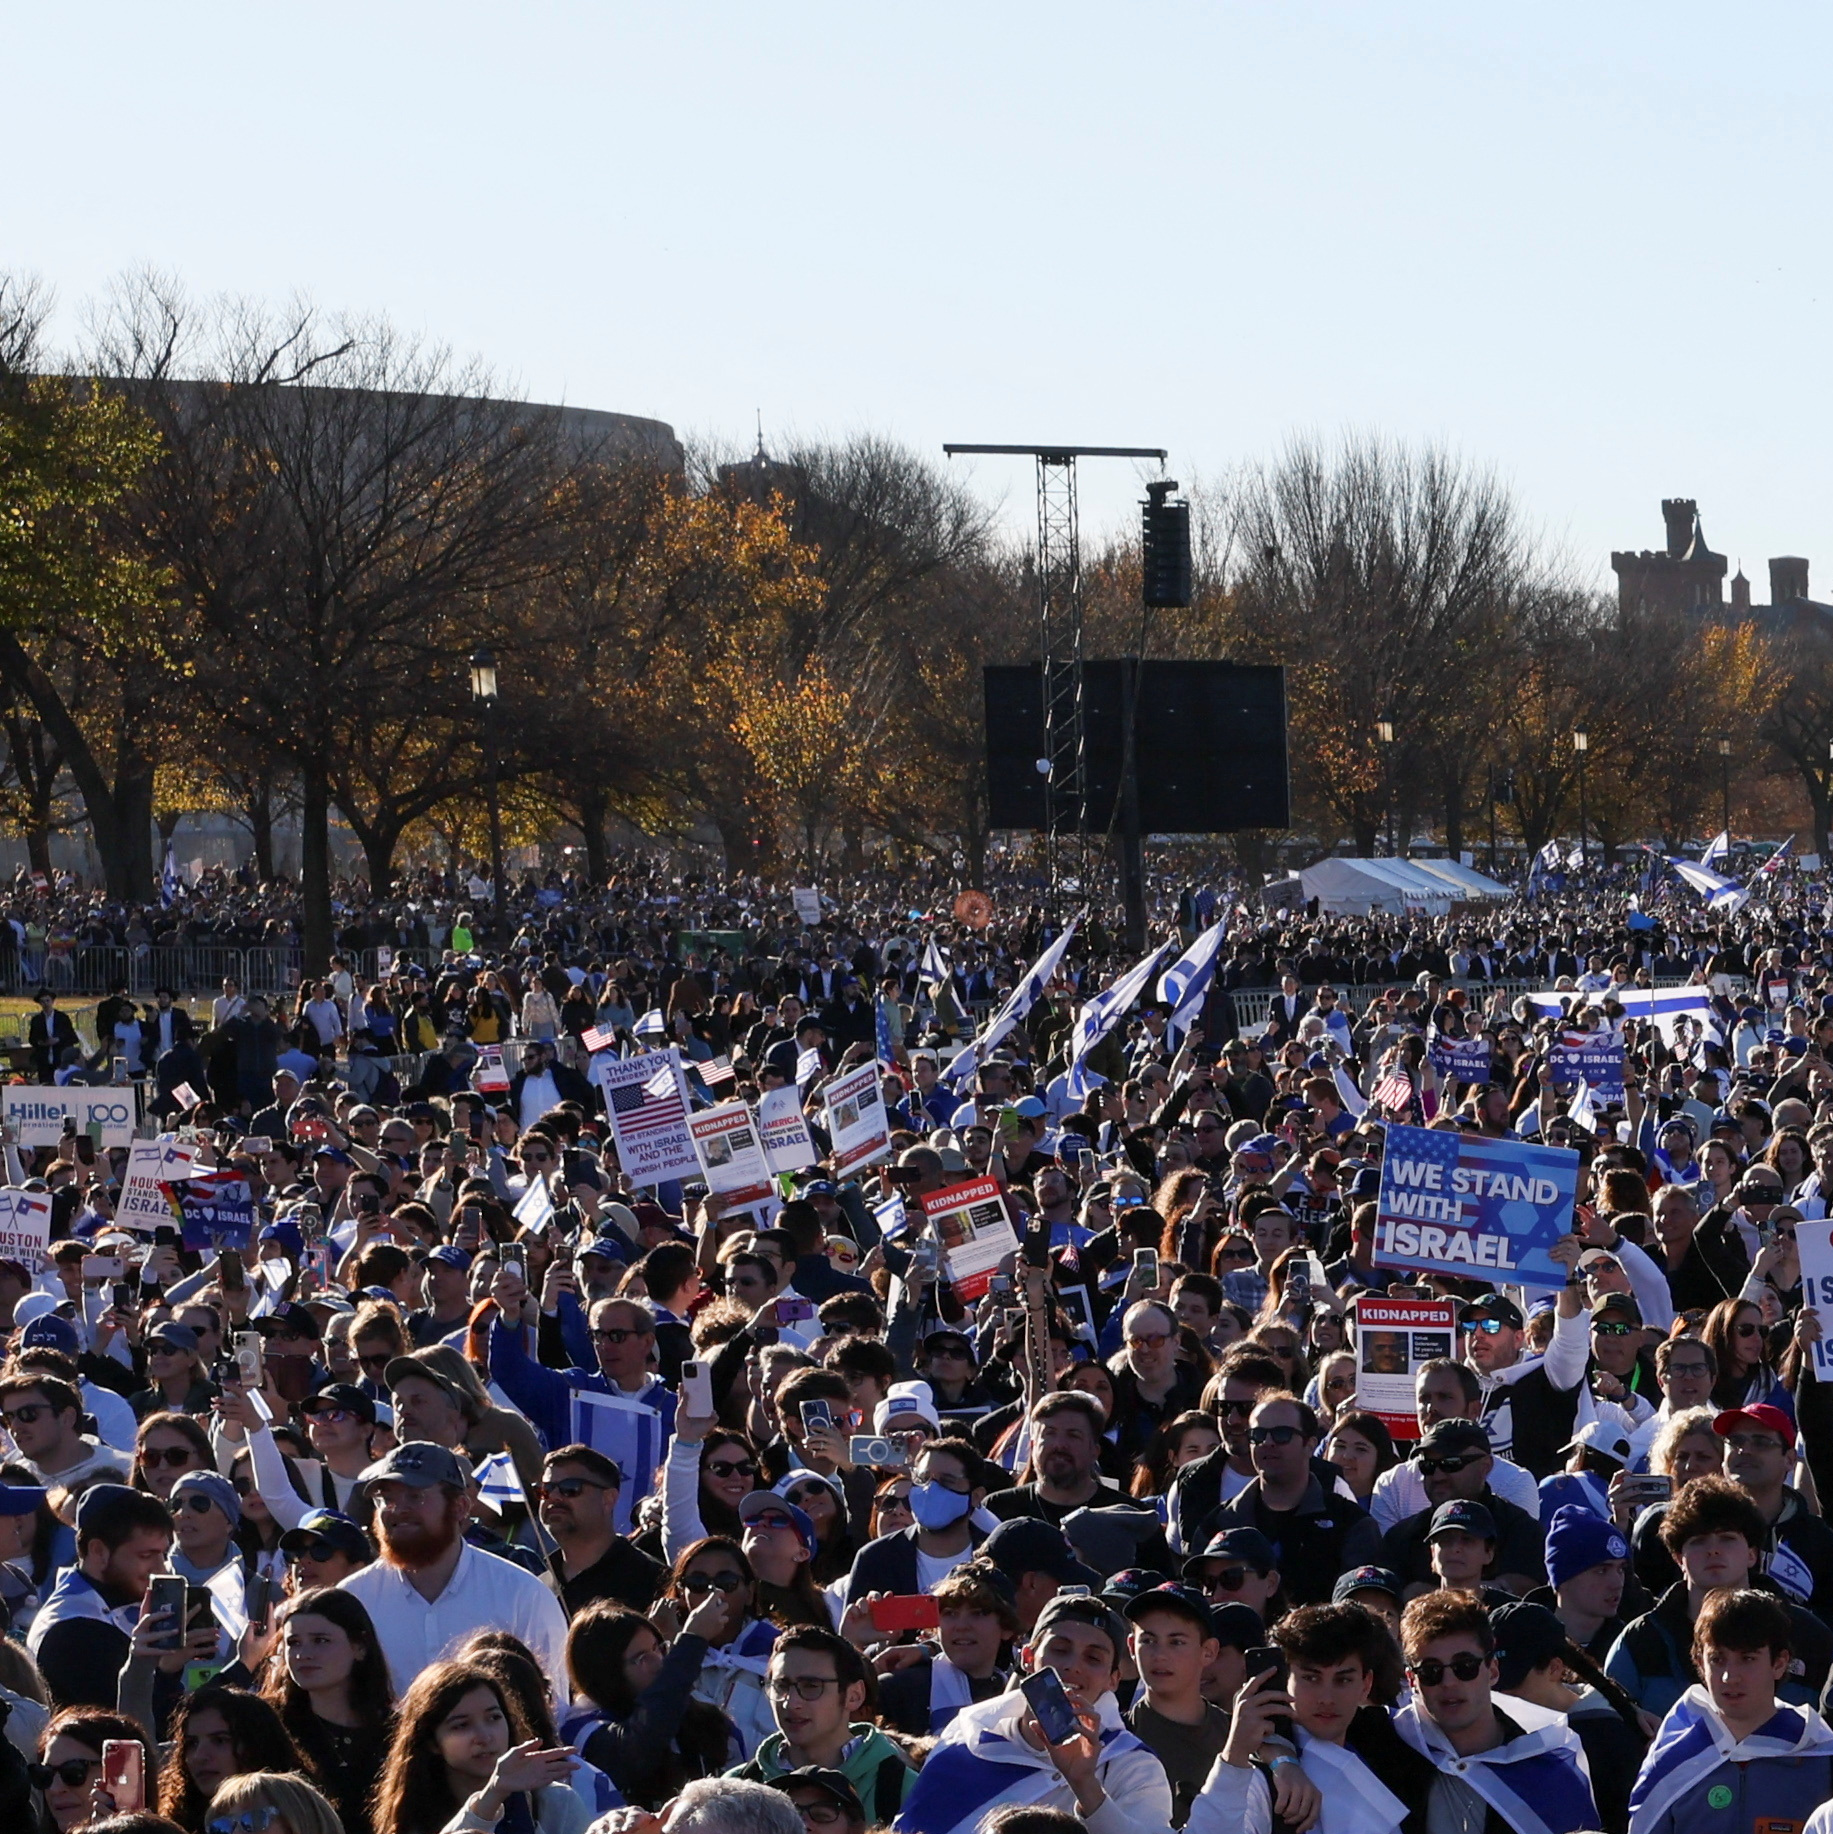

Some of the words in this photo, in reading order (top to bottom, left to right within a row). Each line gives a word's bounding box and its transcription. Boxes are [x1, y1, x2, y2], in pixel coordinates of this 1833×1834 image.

[606, 1058, 647, 1077] THANK
[648, 1053, 672, 1070] YOU
[1549, 1056, 1565, 1064] DC
[1583, 1055, 1622, 1064] ISRAEL
[606, 1069, 651, 1085] PRESIDENT
[831, 1072, 875, 1103] KIDNAPPED
[10, 1102, 67, 1120] Hillel
[694, 1113, 747, 1136] KIDNAPPED
[762, 1115, 801, 1130] AMERICA
[627, 1142, 652, 1155] WITH
[654, 1133, 691, 1150] ISRAEL
[639, 1149, 661, 1162] AND
[662, 1145, 684, 1157] THE
[631, 1163, 662, 1177] JEWISH
[1391, 1158, 1444, 1190] WE
[1451, 1167, 1559, 1205] STAND
[127, 1188, 159, 1198] STANDS
[926, 1183, 994, 1211] KIDNAPPED
[184, 1208, 200, 1220] DC
[217, 1210, 251, 1224] ISRAEL
[1388, 1190, 1463, 1222] WITH
[1383, 1221, 1517, 1270] ISRAEL
[1806, 1277, 1817, 1306] I
[1361, 1308, 1450, 1322] KIDNAPPED
